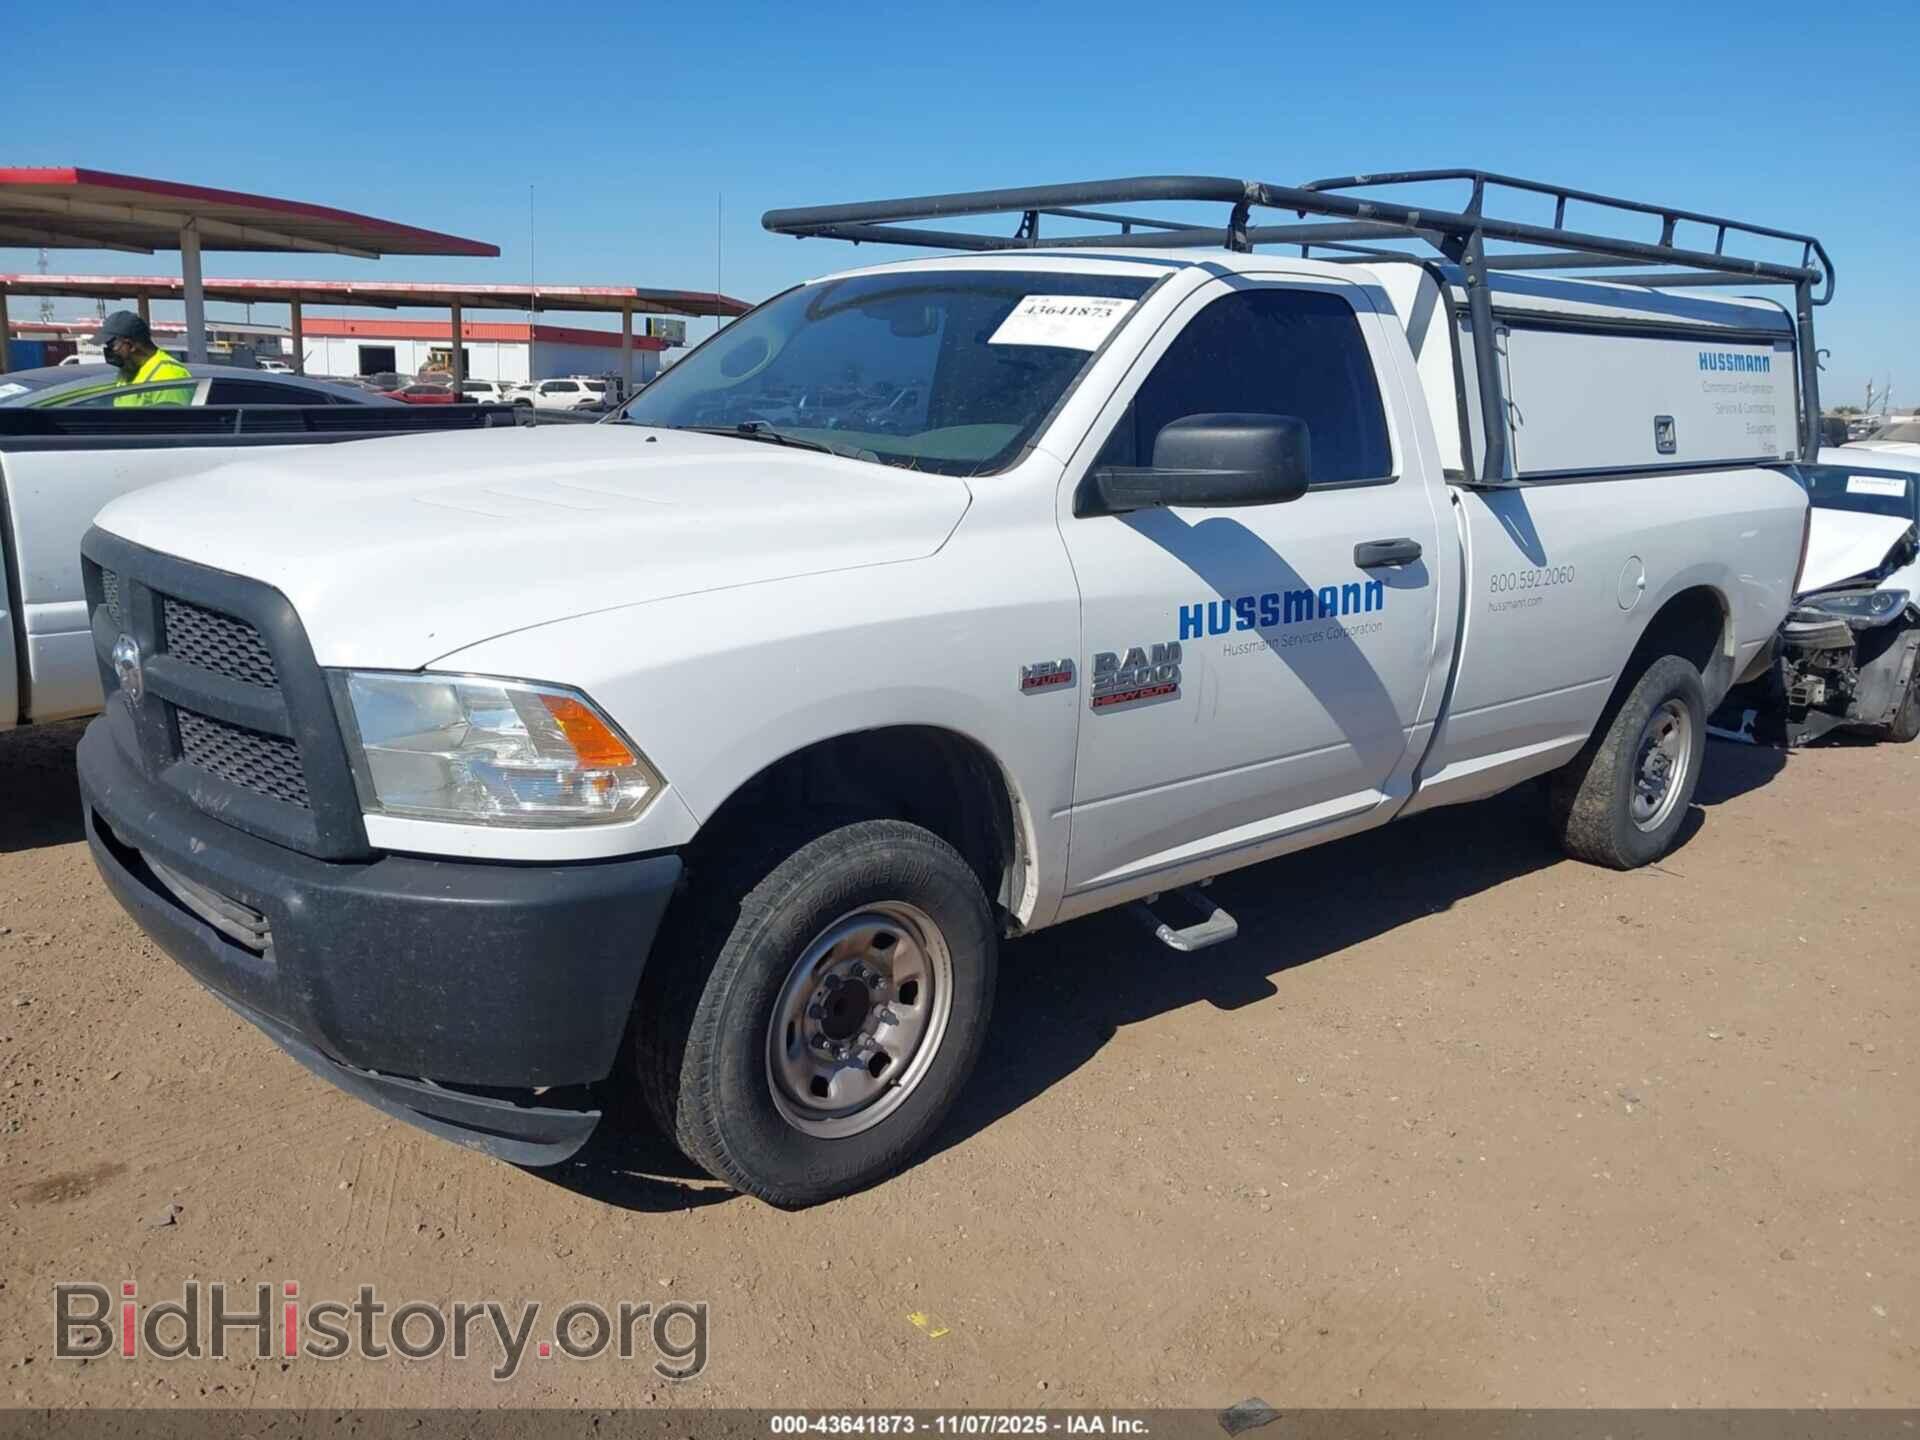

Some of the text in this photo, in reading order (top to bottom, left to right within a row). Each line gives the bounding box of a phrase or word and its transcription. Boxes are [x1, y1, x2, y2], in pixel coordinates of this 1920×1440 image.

[1024, 305, 1113, 317] 43641873
[1490, 565, 1575, 593] 800.592.2060
[1223, 621, 1383, 657] Hussmann Services Corporation
[1094, 641, 1182, 673] RAM
[1094, 689, 1139, 706] HEAVY
